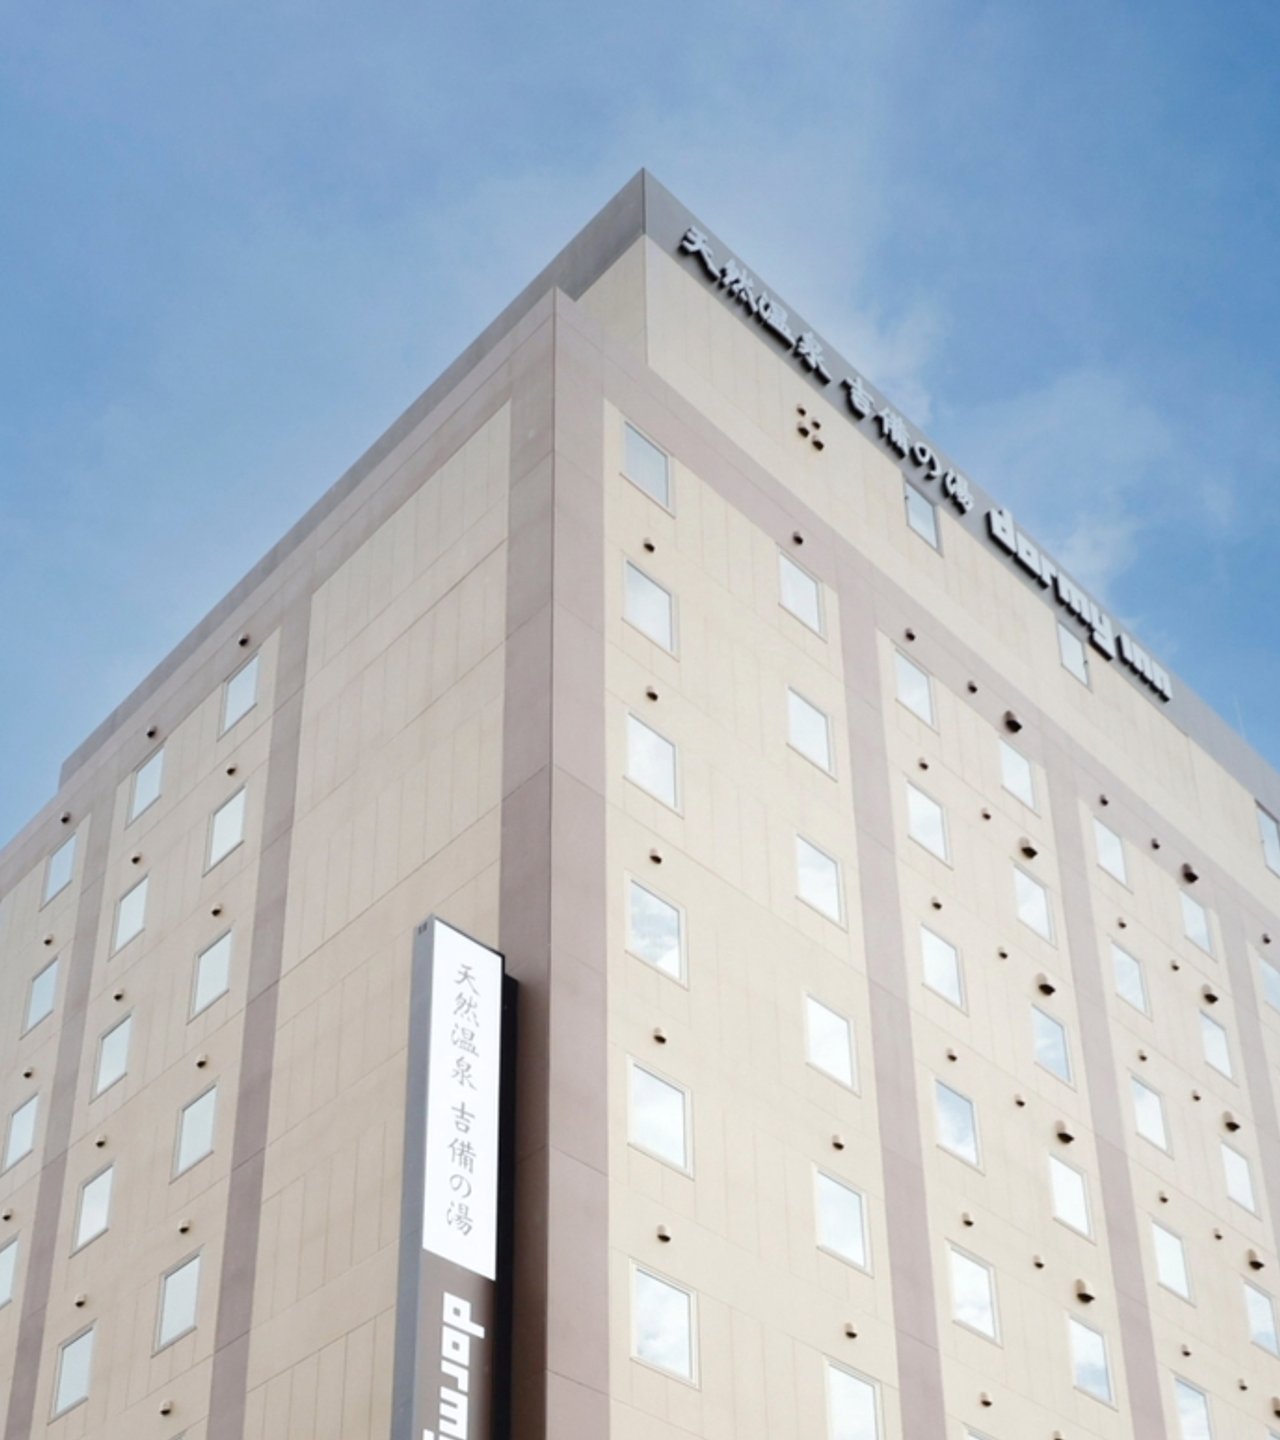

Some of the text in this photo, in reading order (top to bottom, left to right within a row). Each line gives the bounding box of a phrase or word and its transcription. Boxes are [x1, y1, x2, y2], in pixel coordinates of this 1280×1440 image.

[679, 226, 973, 515] 天然温泉 吉備の湯
[985, 507, 1174, 703] dormy inn
[446, 963, 480, 1237] 天然温泉 吉備の湯
